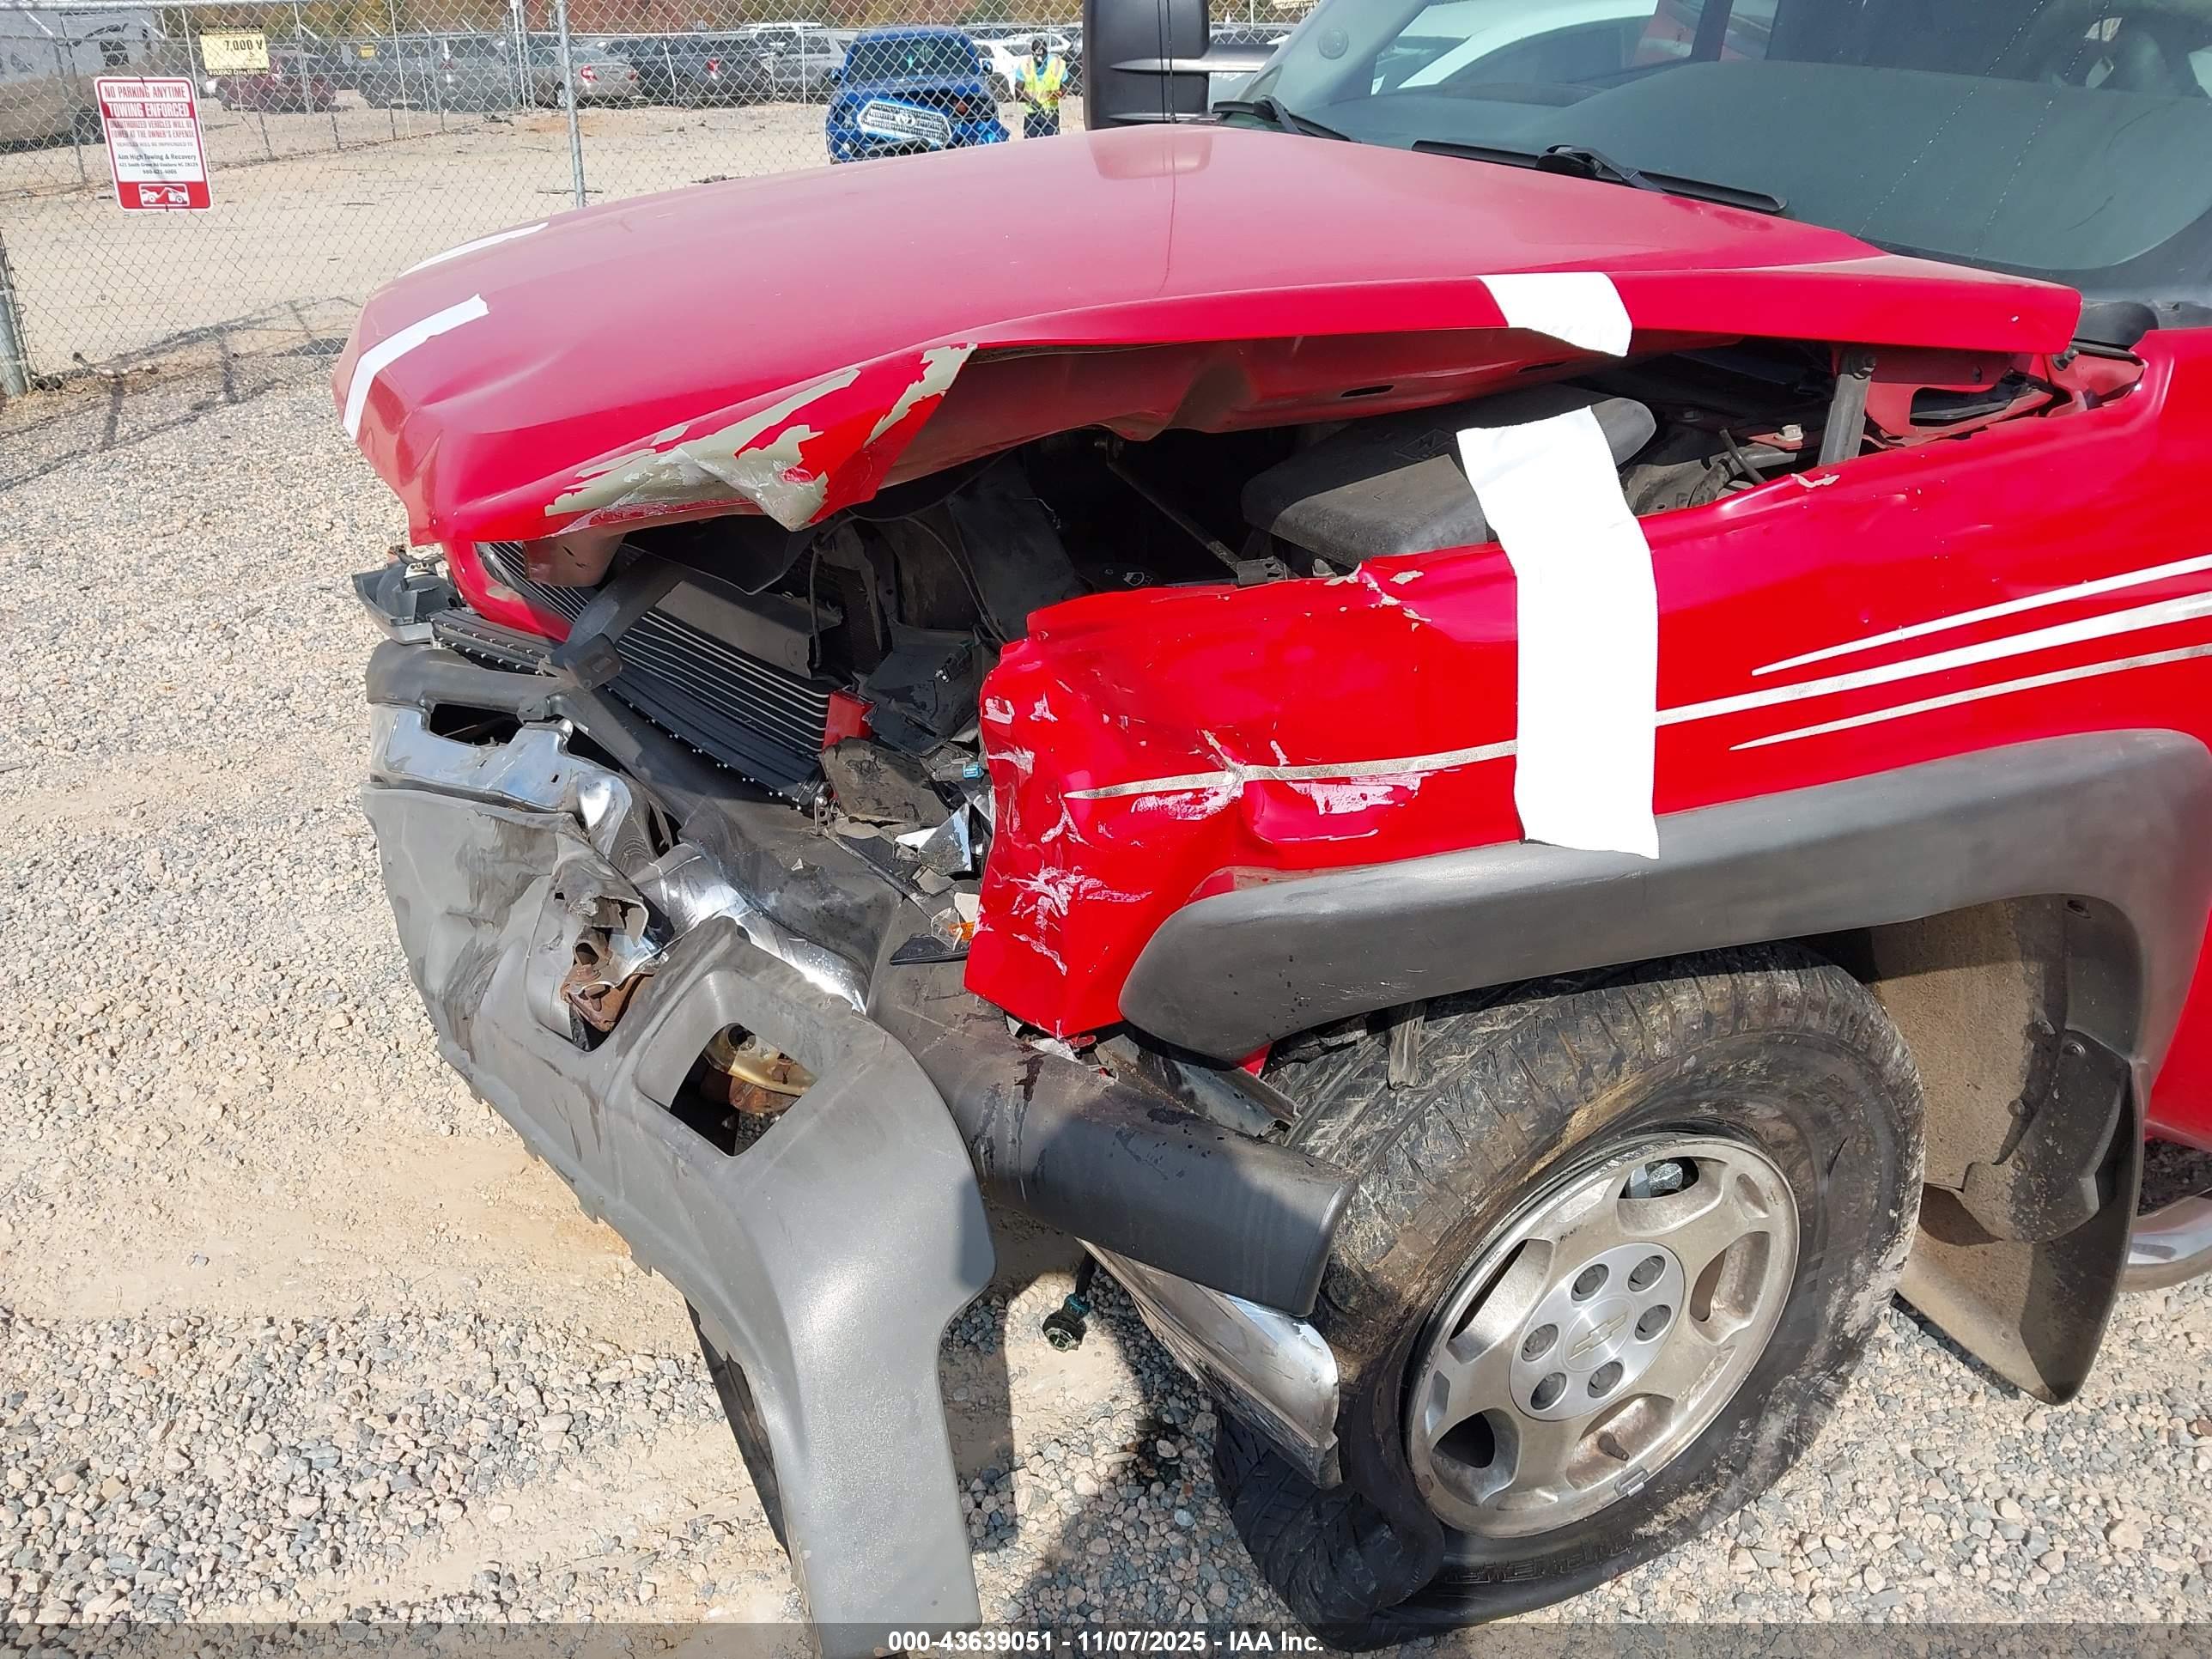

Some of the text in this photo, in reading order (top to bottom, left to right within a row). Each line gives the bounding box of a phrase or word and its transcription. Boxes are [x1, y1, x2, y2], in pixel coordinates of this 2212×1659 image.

[224, 39, 263, 52] 7,000 V
[104, 86, 186, 98] NO PARKING ANYTIME
[108, 103, 190, 118] TOWING ENFORCED
[110, 120, 193, 129] UNAUTHORIZED VEHICLES WILL BE
[111, 130, 195, 138] TOWED AT THE OWNER'S EXPENSE
